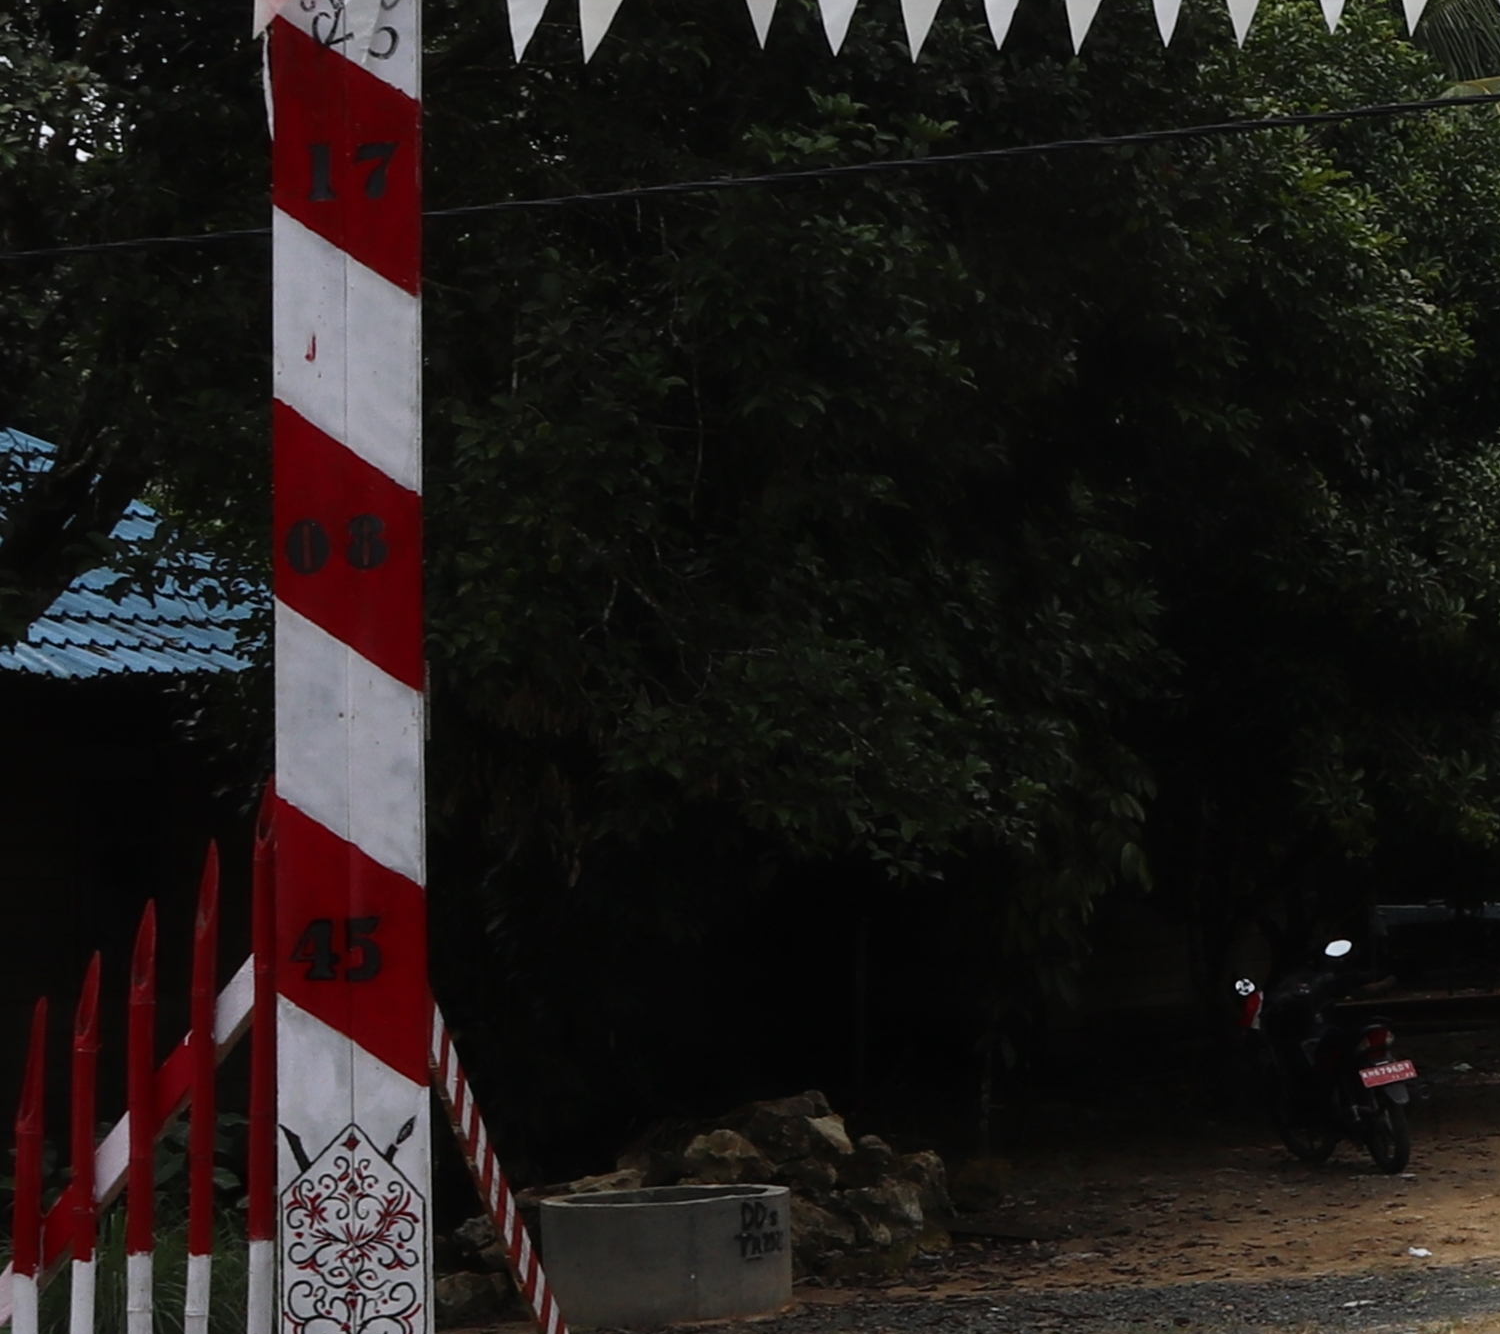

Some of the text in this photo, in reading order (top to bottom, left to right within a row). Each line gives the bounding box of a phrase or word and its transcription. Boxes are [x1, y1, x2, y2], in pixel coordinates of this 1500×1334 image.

[307, 140, 400, 202] 17
[284, 513, 388, 575] 08
[291, 916, 382, 983] 45
